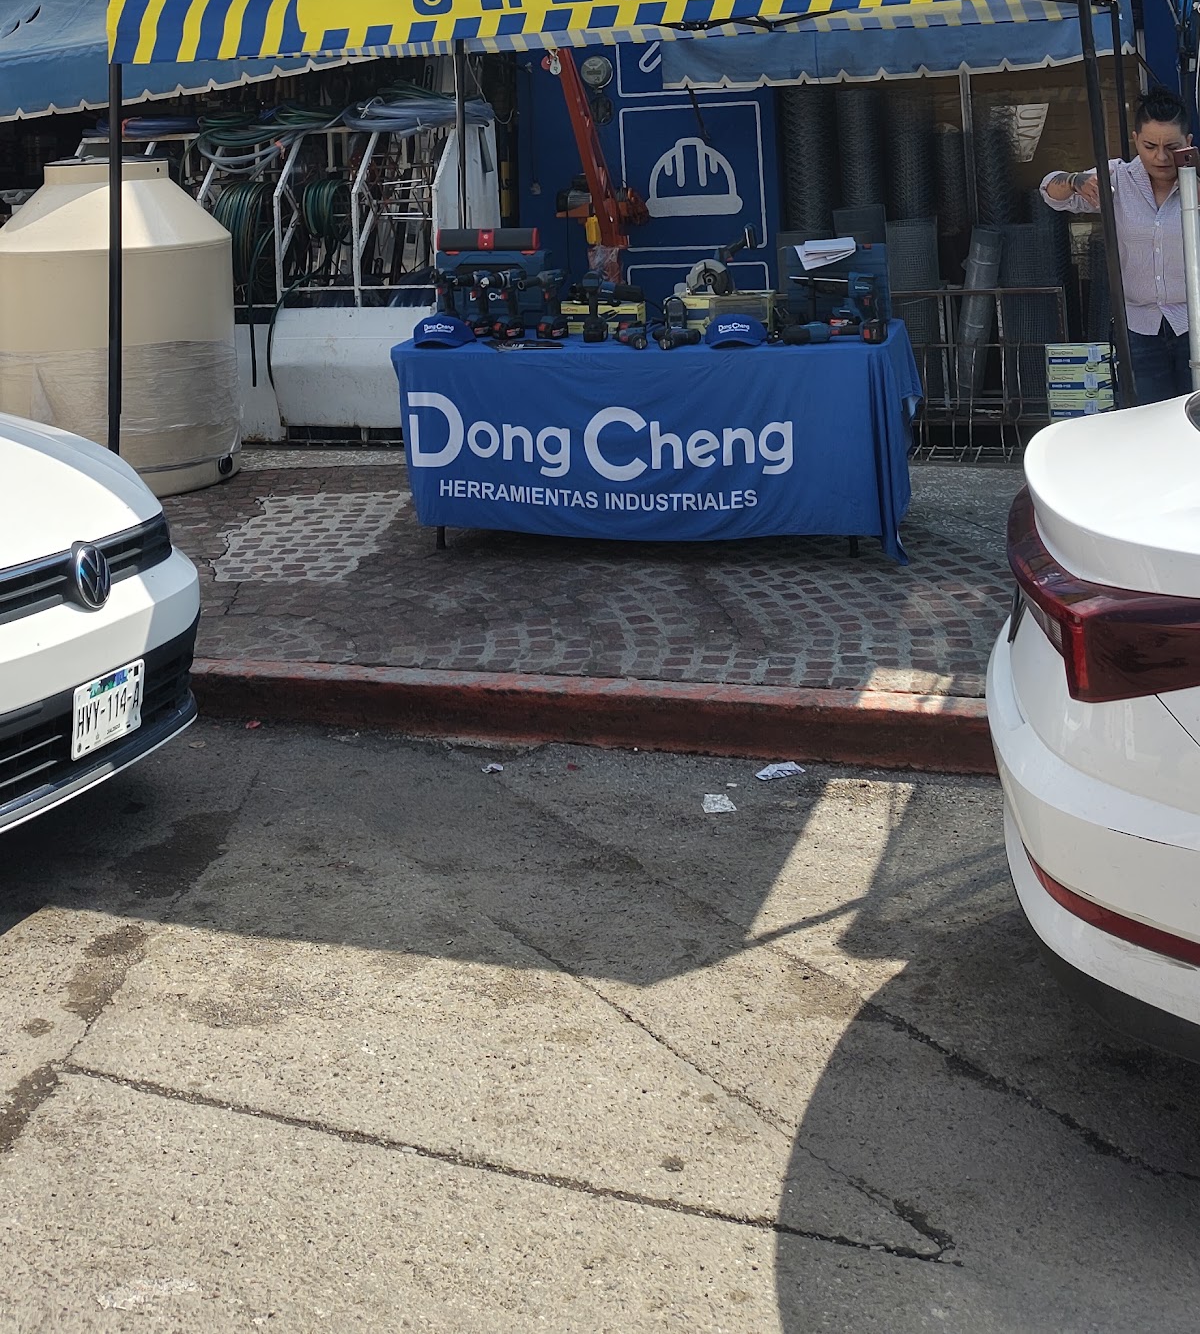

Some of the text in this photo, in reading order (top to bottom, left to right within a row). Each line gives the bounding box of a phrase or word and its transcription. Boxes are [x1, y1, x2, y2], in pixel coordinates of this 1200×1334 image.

[407, 391, 794, 481] Dong Cheng
[439, 478, 759, 512] HERRAMIENTAS INDUSTRIALES
